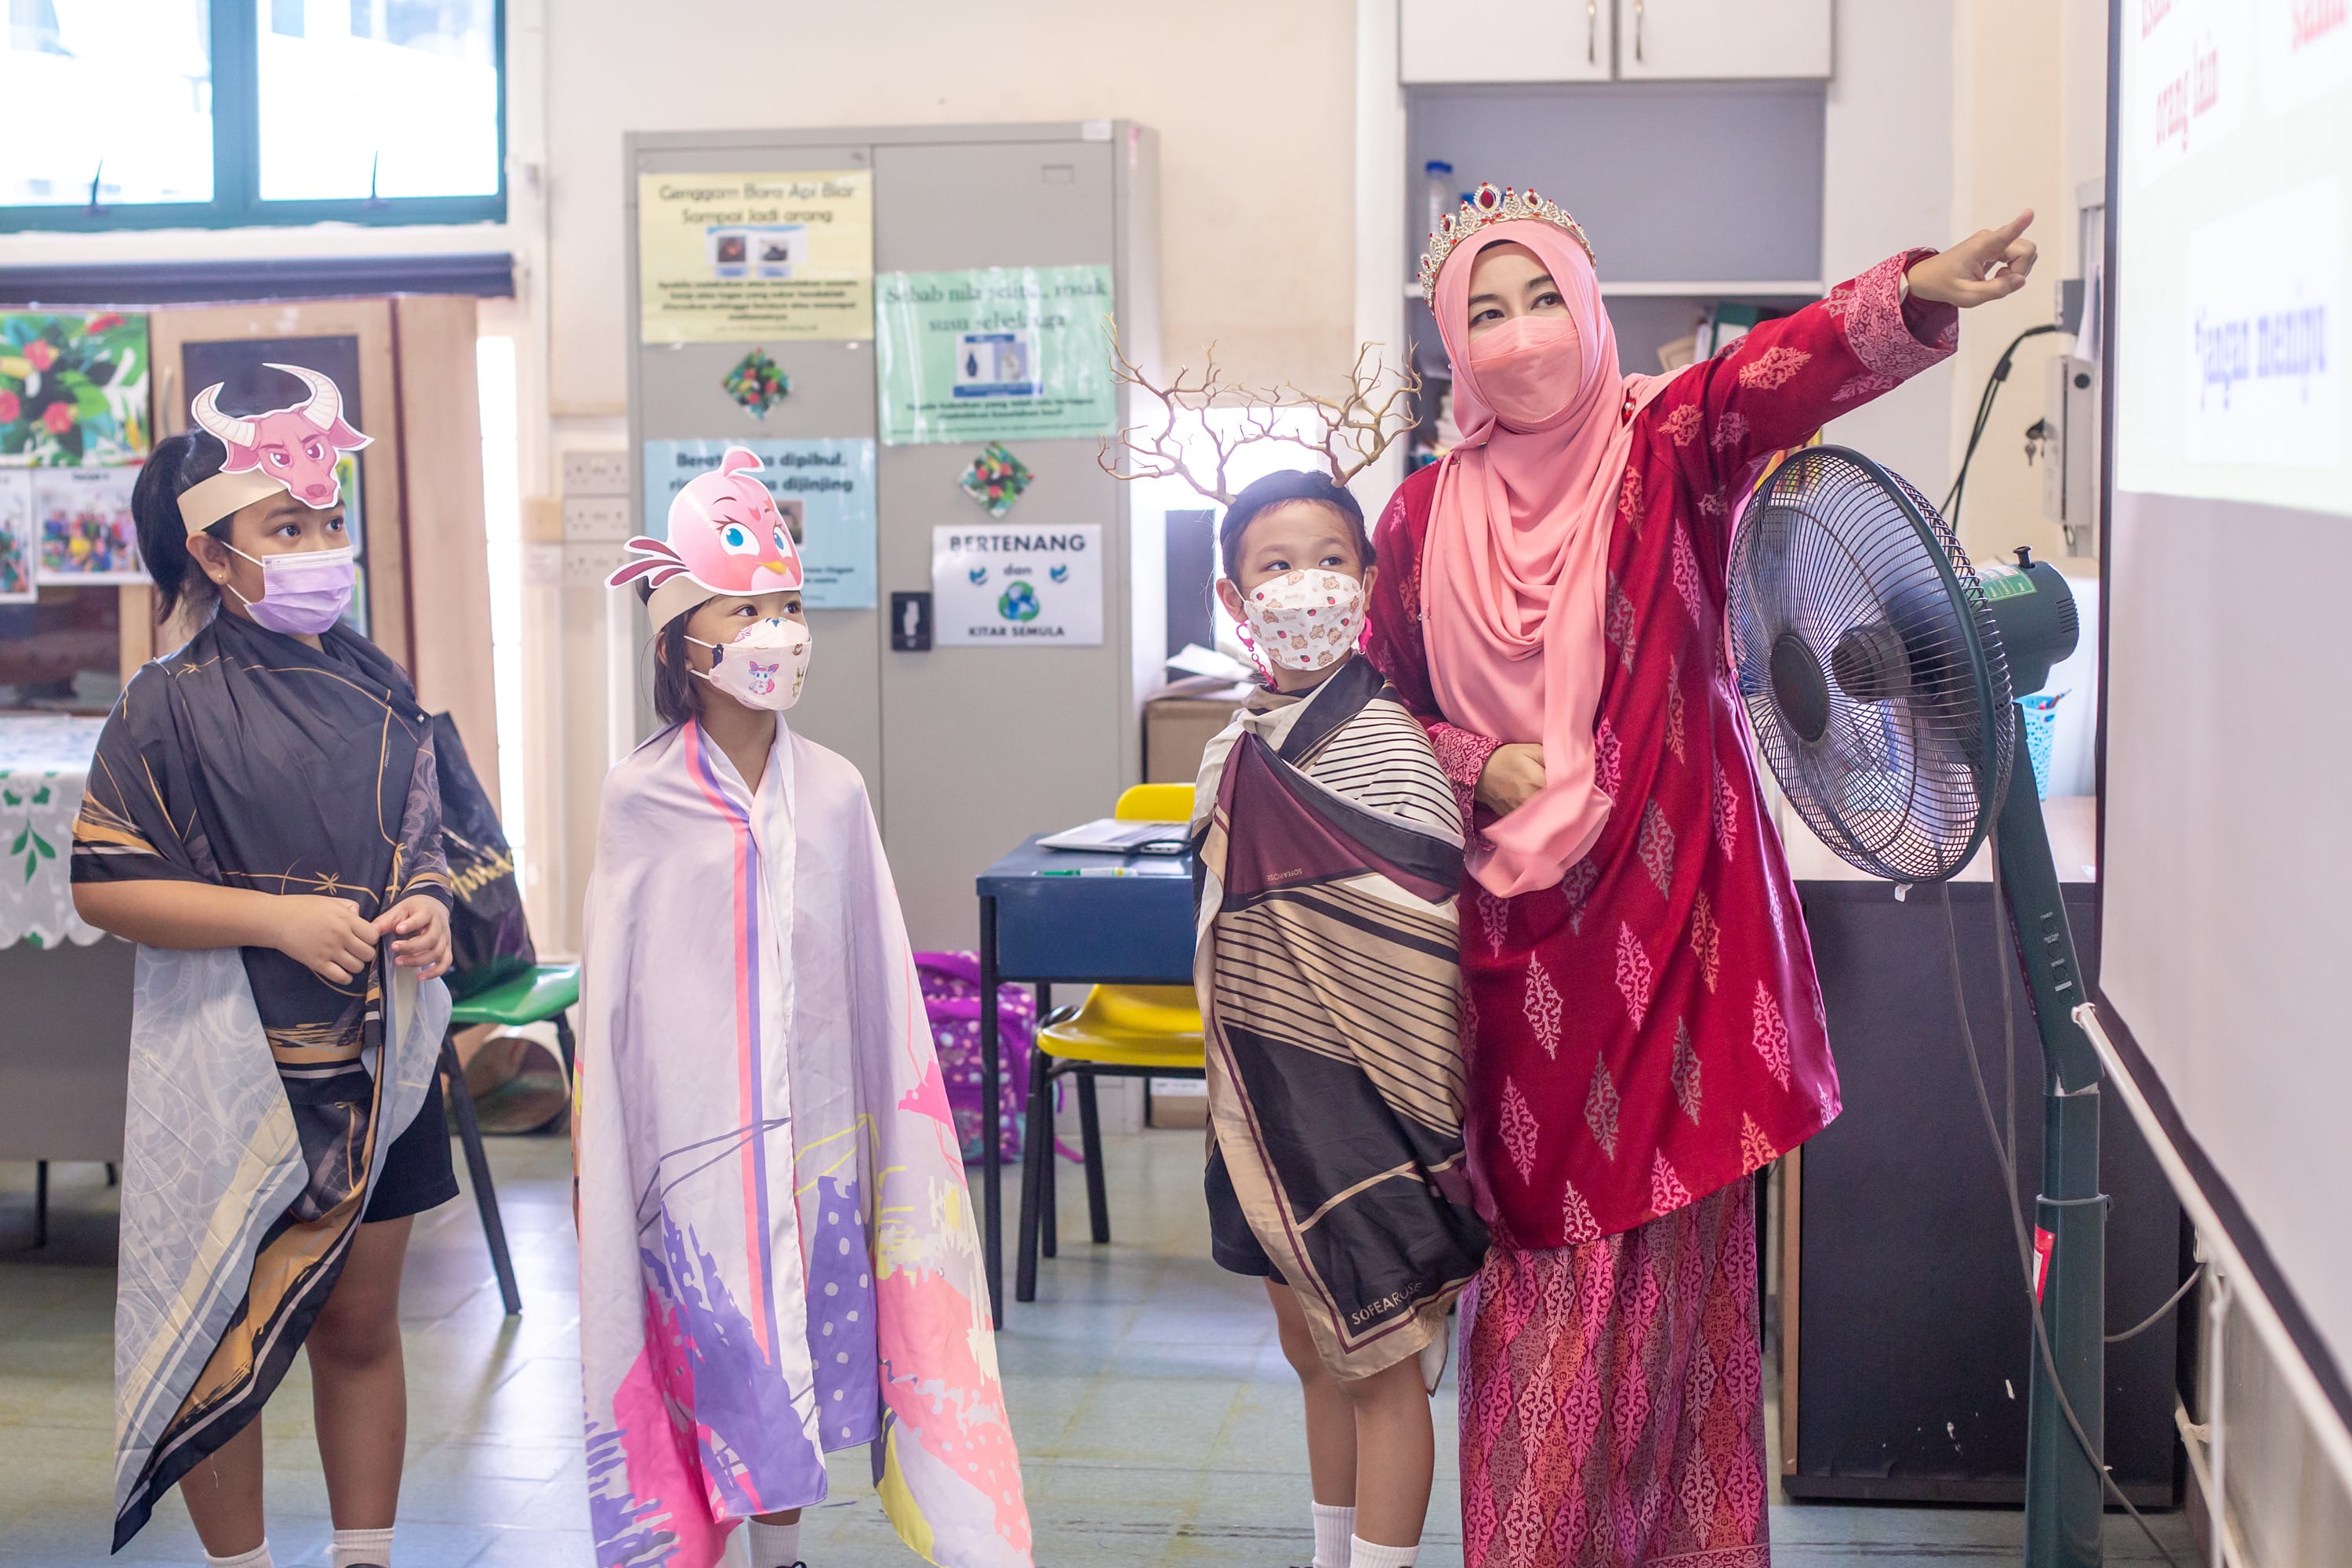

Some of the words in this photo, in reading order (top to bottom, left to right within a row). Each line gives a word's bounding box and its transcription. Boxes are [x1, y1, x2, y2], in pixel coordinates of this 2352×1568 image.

[950, 535, 1085, 550] BERTENANG
[1004, 564, 1032, 575] dan
[968, 626, 1007, 637] KITAR
[1011, 626, 1064, 637] SEMULA
[1266, 868, 1302, 881] SOFEAROSE
